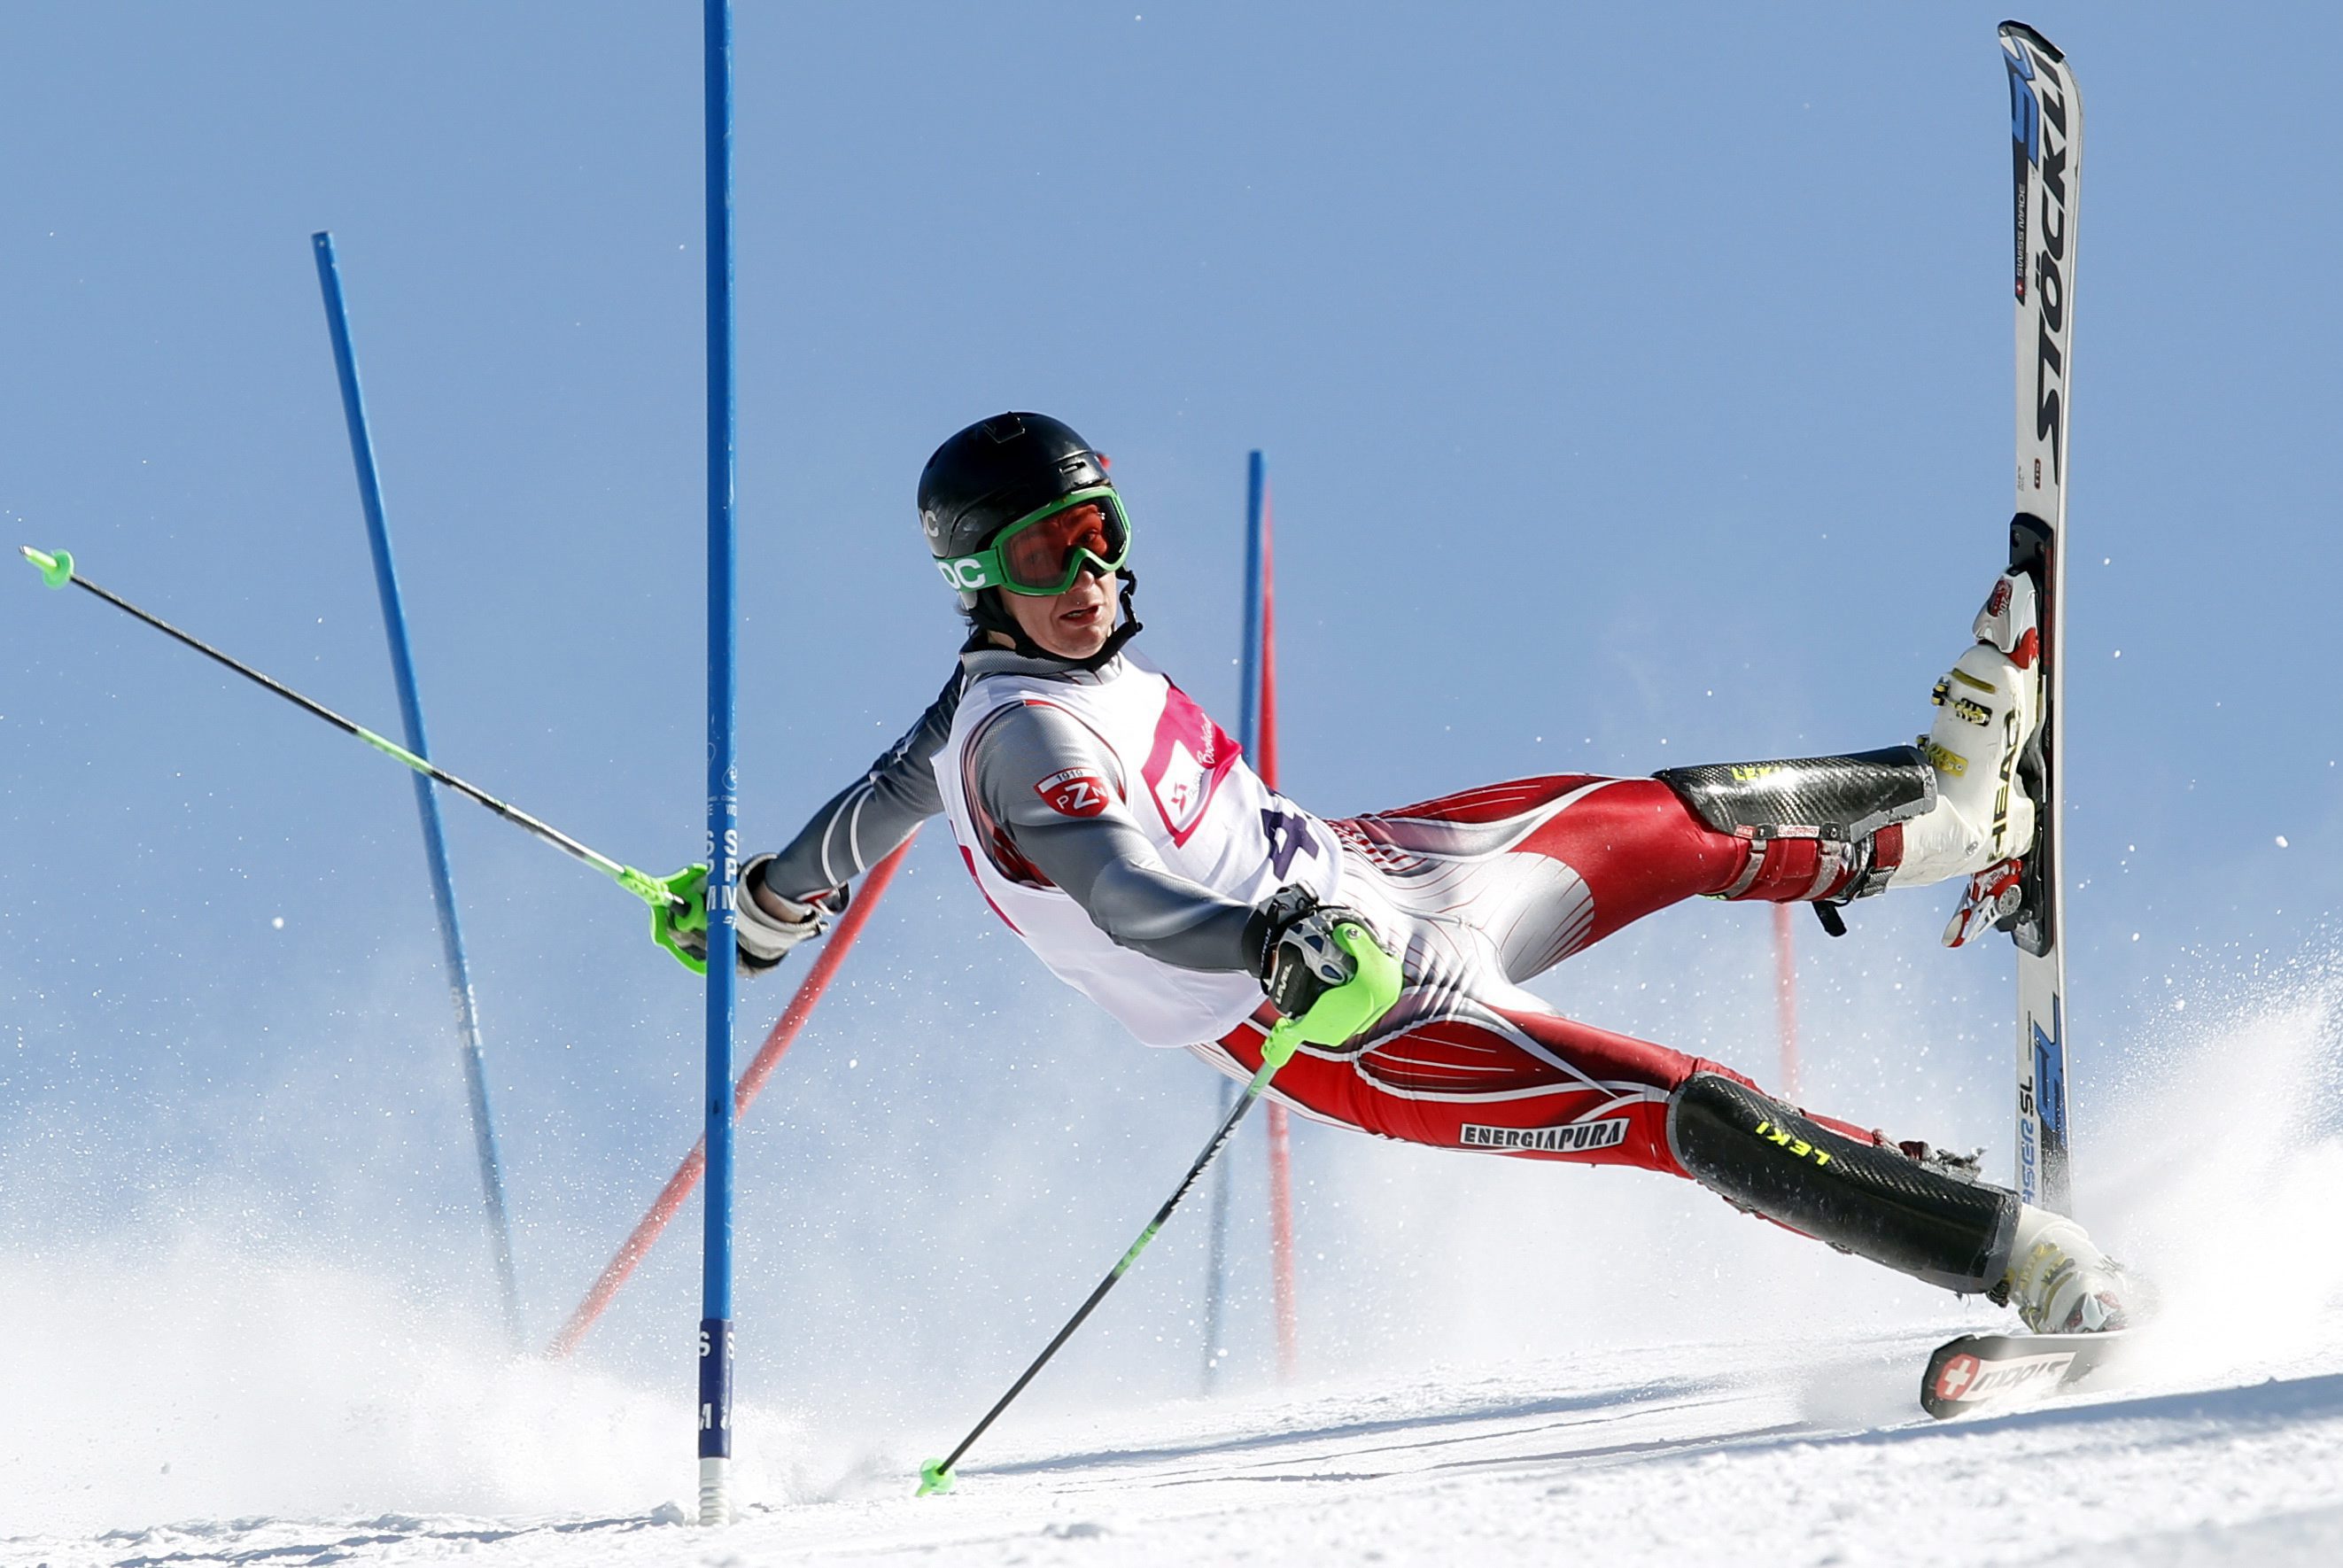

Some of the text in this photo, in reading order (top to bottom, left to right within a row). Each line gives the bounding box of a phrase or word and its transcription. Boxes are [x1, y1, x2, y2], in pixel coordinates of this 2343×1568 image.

[2016, 230, 2025, 277] SWISS
[2029, 47, 2067, 485] STÖCKLI
[936, 558, 986, 589] OC
[1056, 769, 1083, 781] 1919
[1261, 790, 1319, 882] 4
[1275, 963, 1293, 1005] LEVEL
[2020, 1075, 2034, 1117] SL
[1464, 1121, 1622, 1150] ENERGIAPURA
[1755, 1121, 1831, 1167] LEKI
[2021, 1118, 2036, 1205] ASER
